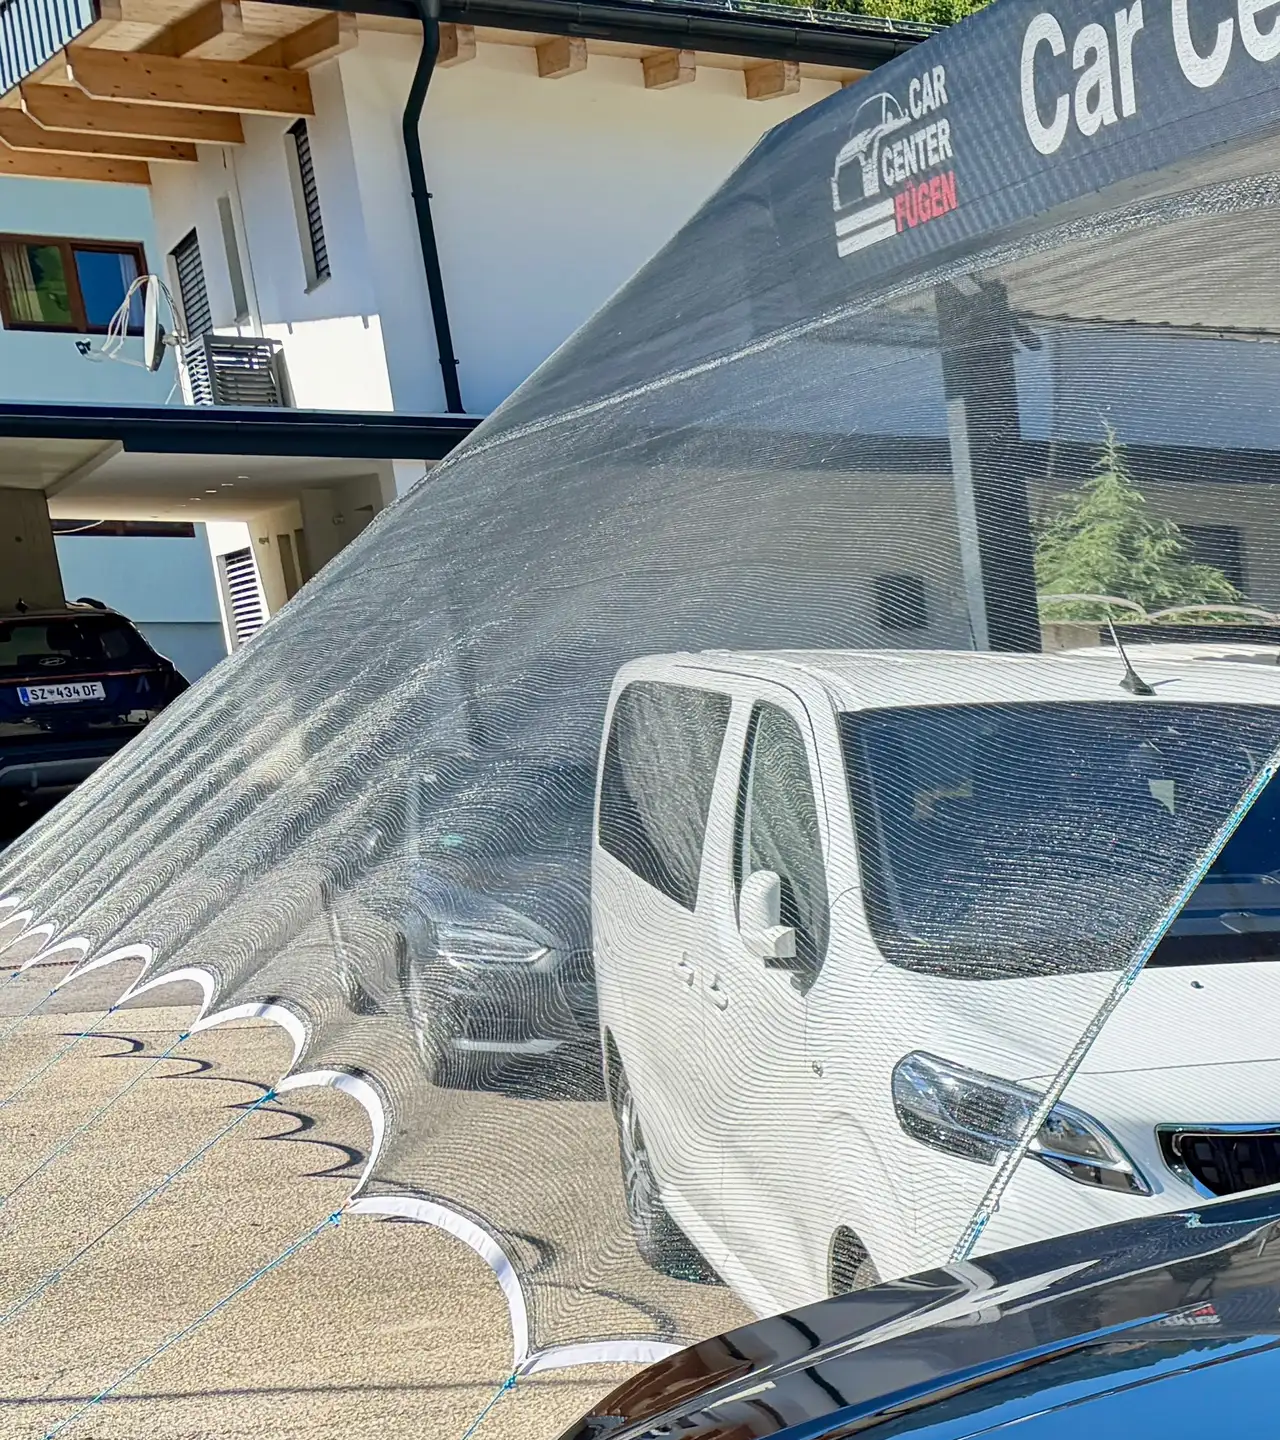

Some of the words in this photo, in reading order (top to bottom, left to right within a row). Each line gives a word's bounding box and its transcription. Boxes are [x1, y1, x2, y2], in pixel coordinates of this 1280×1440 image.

[908, 64, 949, 120] CAR
[1020, 0, 1143, 155] Car
[881, 118, 953, 187] CENTER
[894, 170, 958, 233] FÜGEN
[30, 689, 48, 701] SZ
[56, 684, 81, 698] 434
[83, 684, 98, 696] DF
